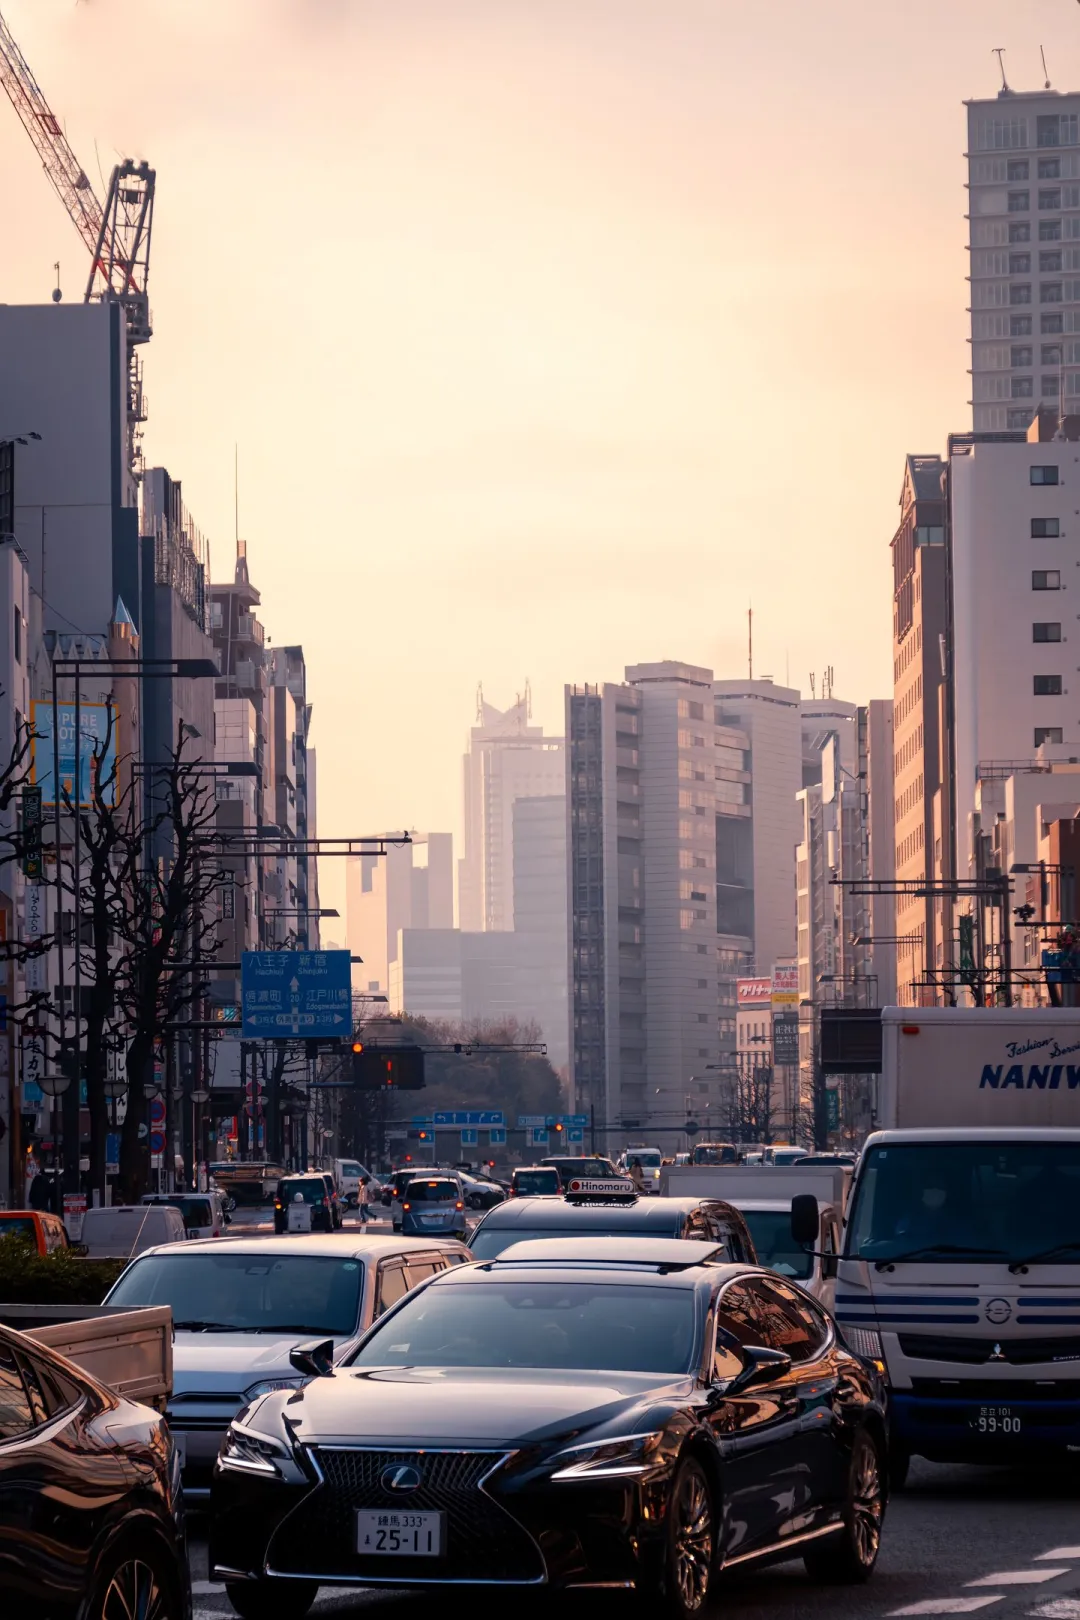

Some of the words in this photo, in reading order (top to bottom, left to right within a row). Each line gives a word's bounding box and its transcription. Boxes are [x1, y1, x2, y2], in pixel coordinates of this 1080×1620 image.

[249, 955, 289, 967] 八王子
[298, 954, 327, 967] 新宿
[297, 968, 328, 976] Shinjuku
[306, 989, 349, 1002] 江戸川橋
[1005, 1037, 1055, 1058] Fashion
[581, 1182, 630, 1191] Hinomaru
[978, 1417, 1021, 1432] 99-00
[377, 1516, 400, 1527] 練馬
[402, 1516, 423, 1527] 333
[376, 1529, 432, 1552] 25-11
